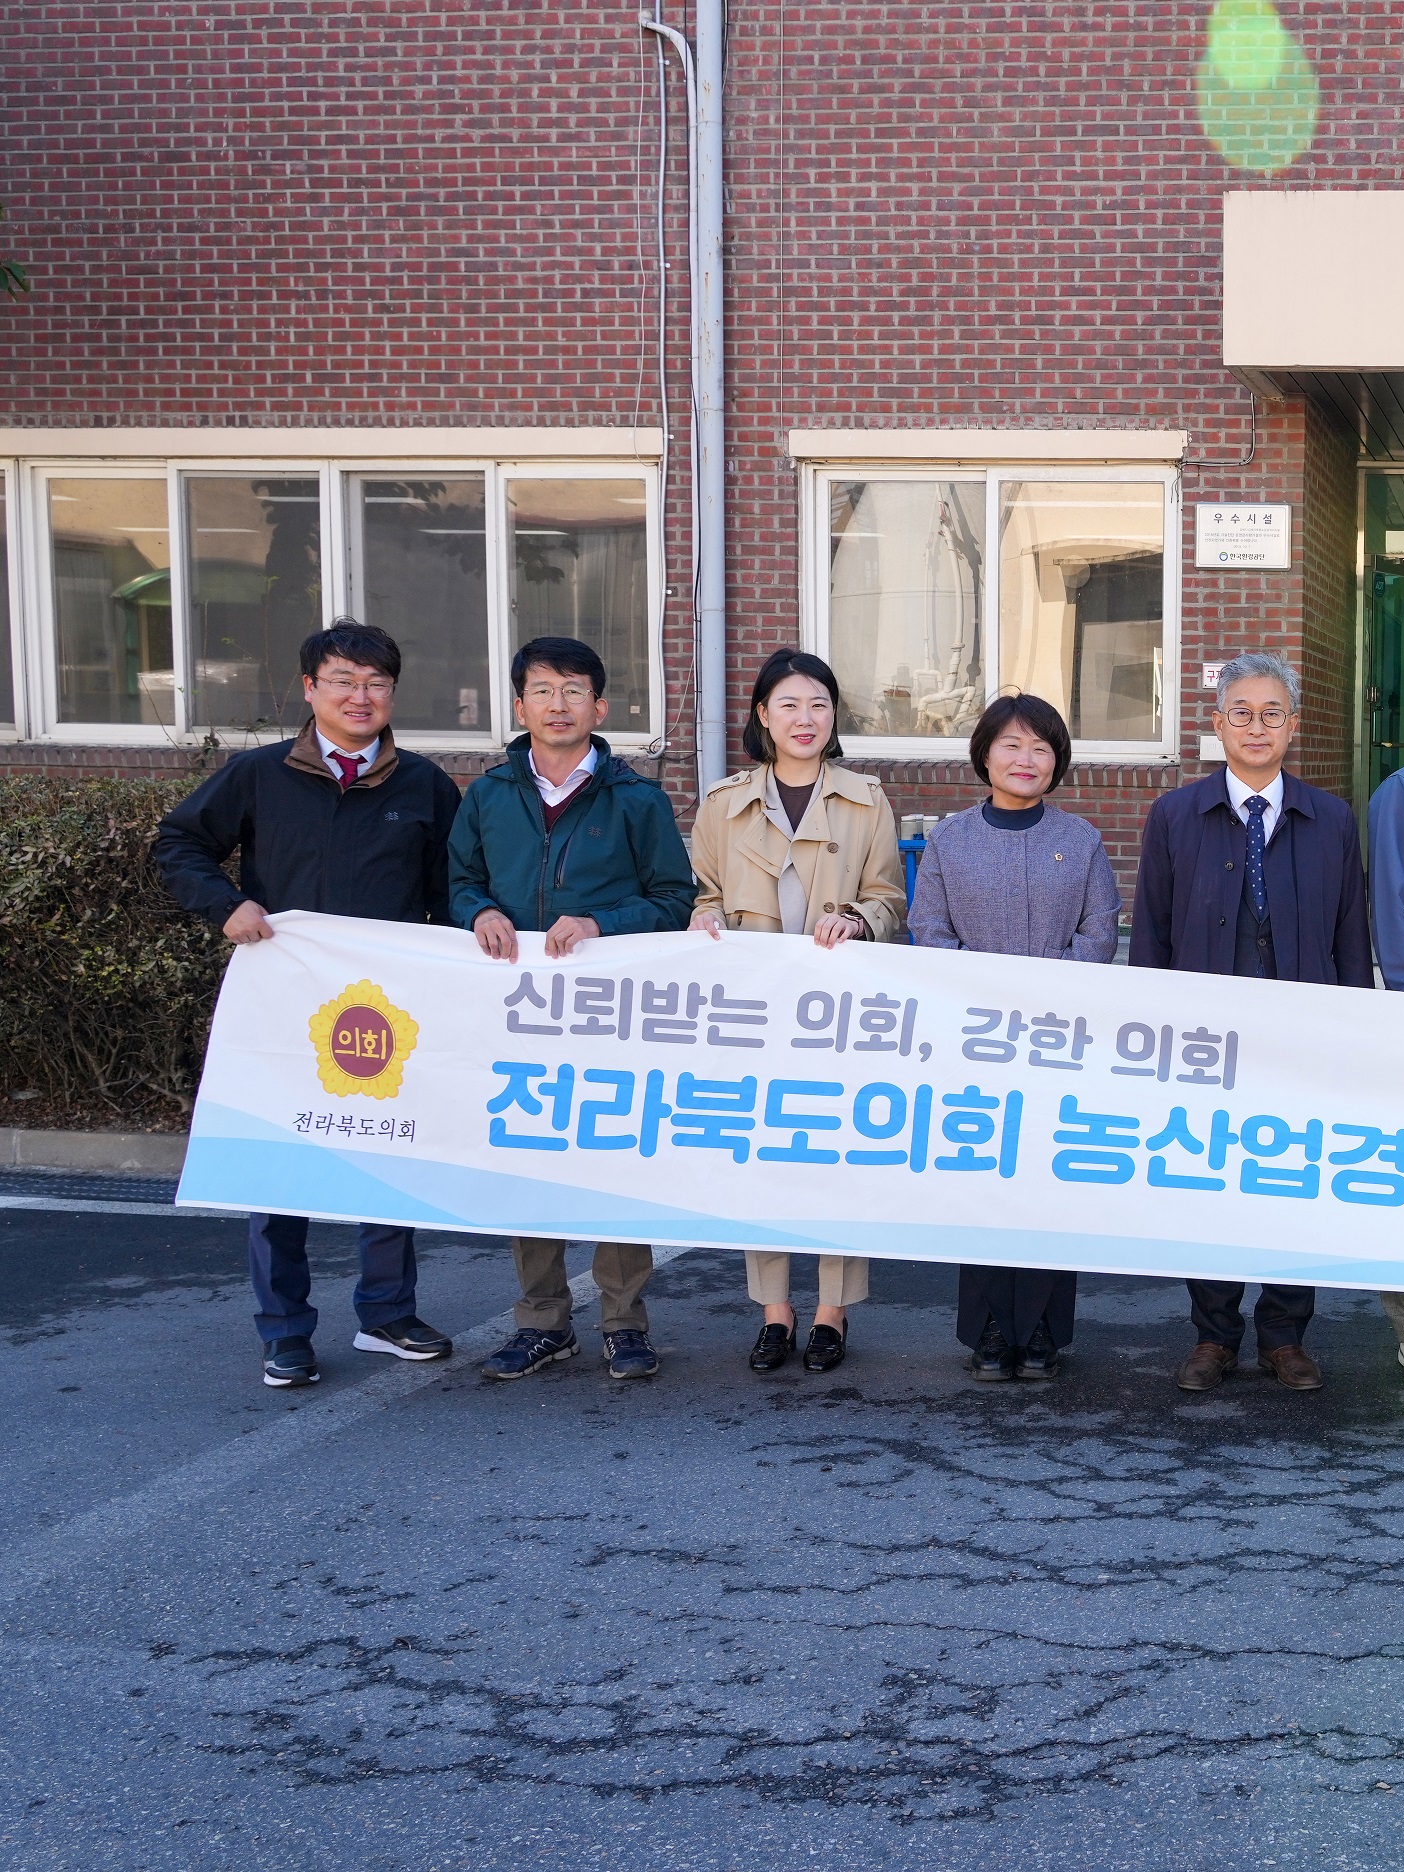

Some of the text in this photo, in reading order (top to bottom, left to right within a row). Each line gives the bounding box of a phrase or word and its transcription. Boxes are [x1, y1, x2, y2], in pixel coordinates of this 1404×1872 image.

[1213, 512, 1273, 525] 우수시설
[334, 1026, 388, 1061] 의회
[503, 970, 1240, 1091] 신뢰받는 의회, 강한 의회
[292, 1110, 418, 1143] 전라북도의회
[486, 1060, 1024, 1179] 전라북도의회
